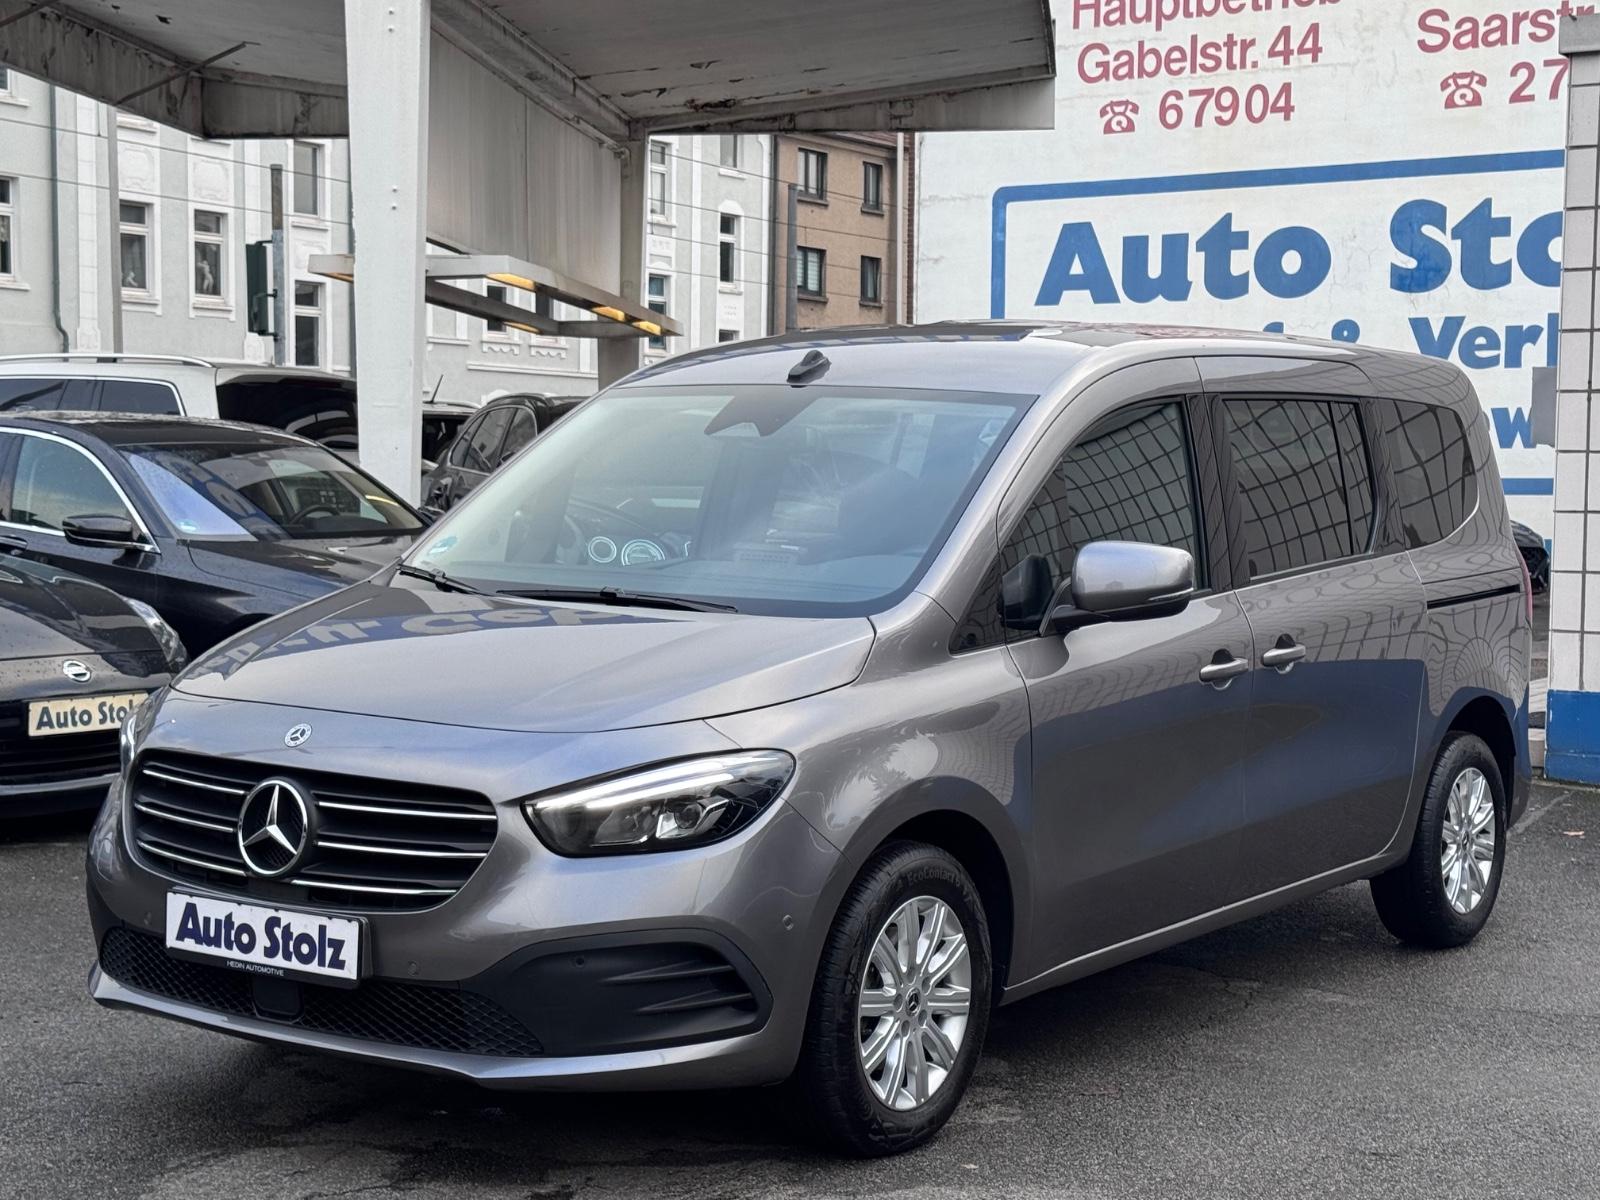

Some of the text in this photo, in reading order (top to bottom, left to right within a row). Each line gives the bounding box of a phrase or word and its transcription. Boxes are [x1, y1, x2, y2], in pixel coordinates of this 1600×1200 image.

[1073, 0, 1341, 32] Hauptb
[1077, 22, 1323, 84] Gabelstr. 44
[1158, 82, 1295, 131] 67904
[1034, 212, 1332, 307] Auto
[36, 706, 92, 731] Auto
[175, 901, 346, 970] Auto Stolz
[226, 960, 285, 977] HEDIN AUTOMOTIVE
